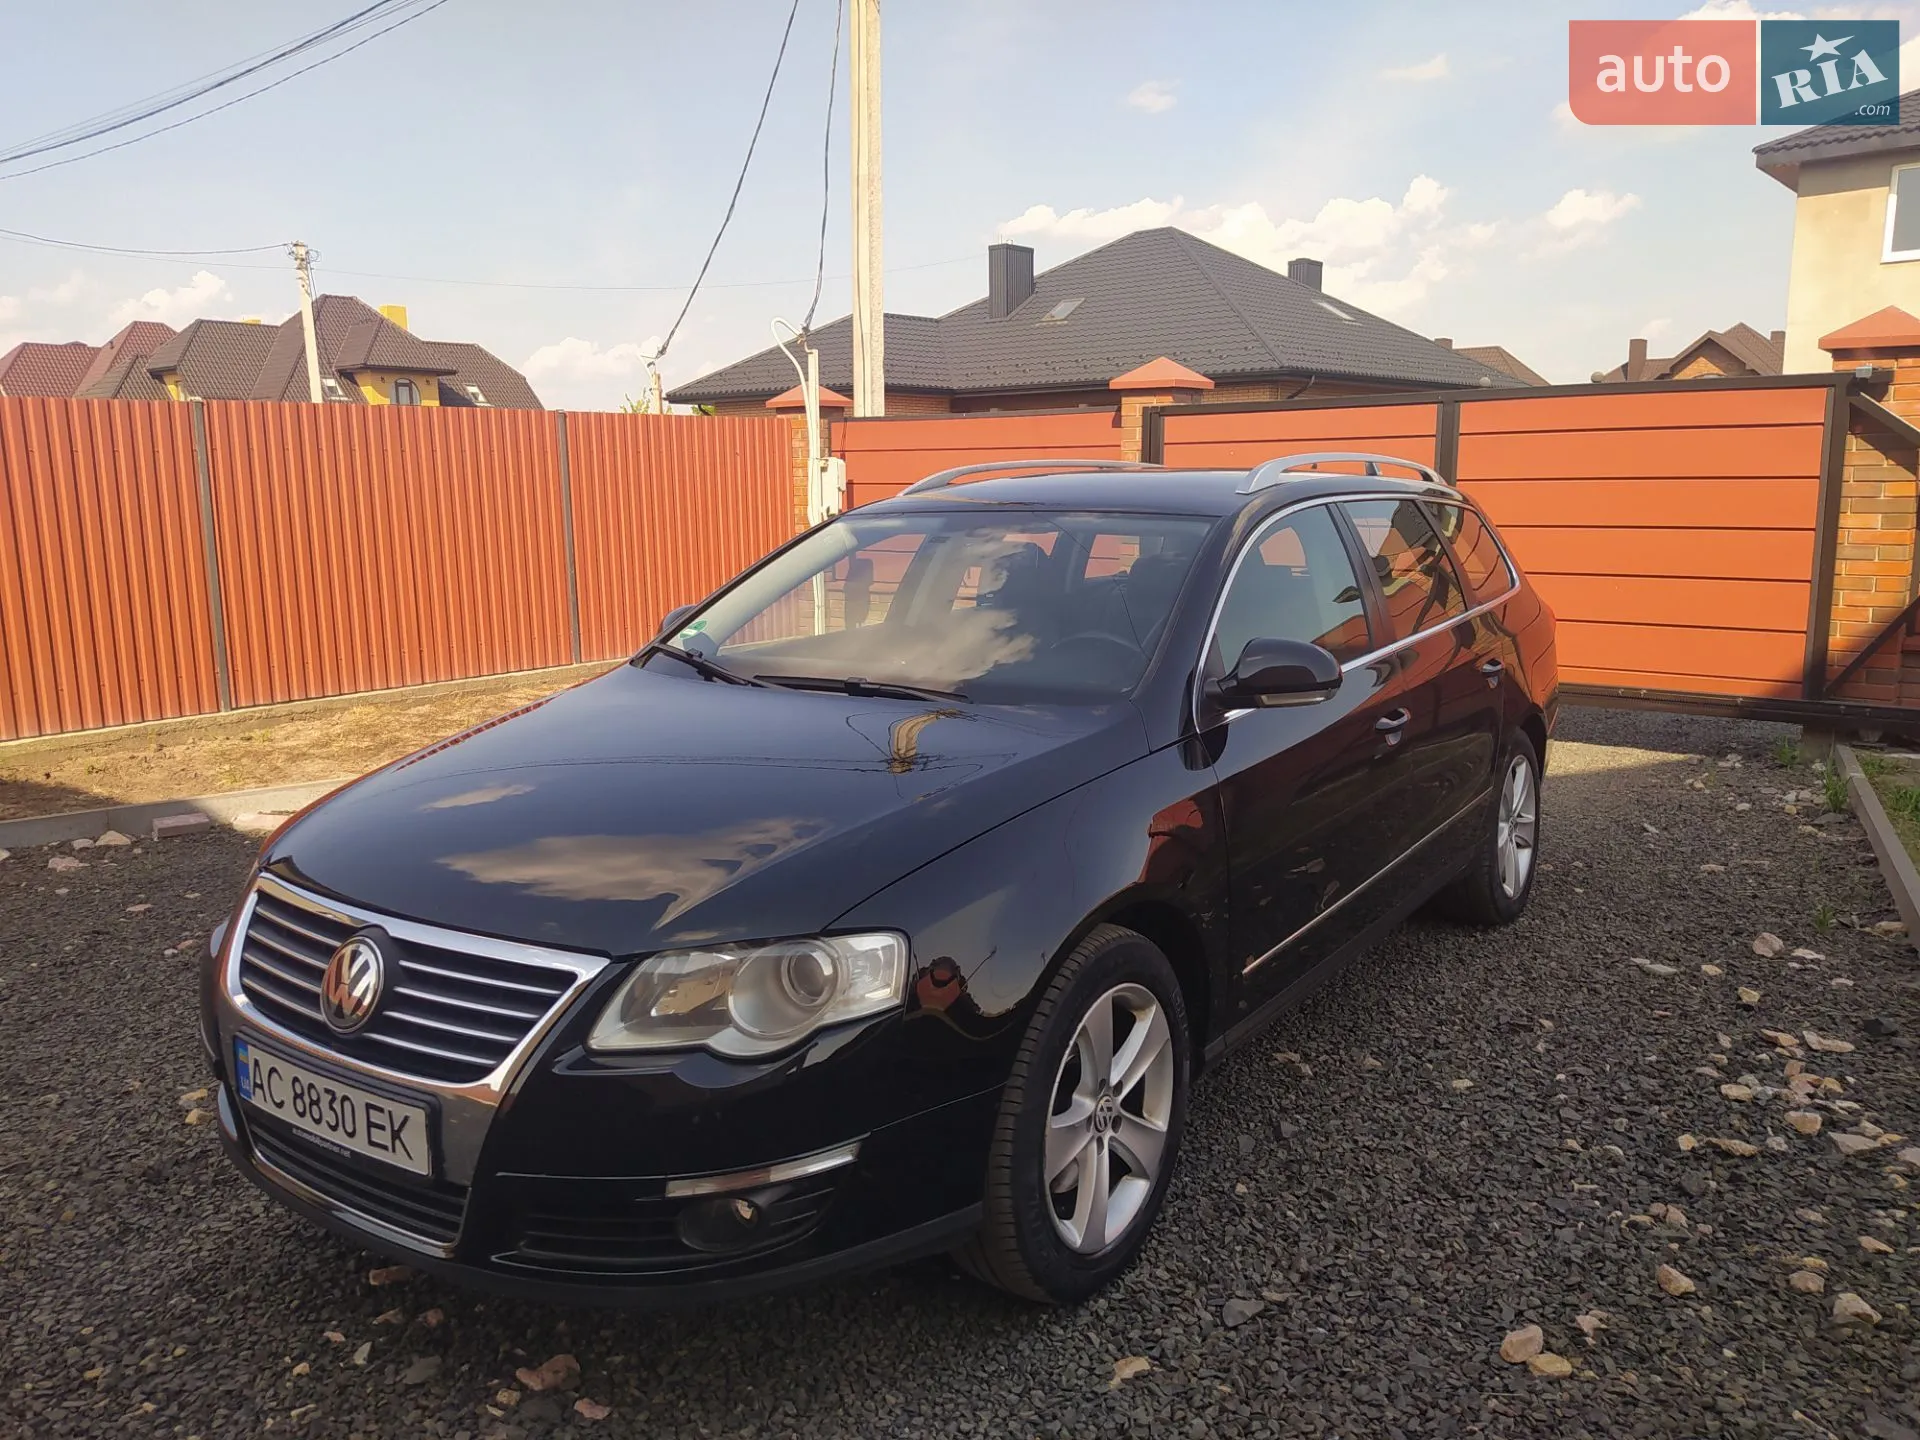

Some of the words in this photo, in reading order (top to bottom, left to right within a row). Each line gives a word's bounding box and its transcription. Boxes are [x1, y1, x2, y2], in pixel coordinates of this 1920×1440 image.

[252, 1058, 285, 1109] AC
[291, 1076, 357, 1139] 8830
[365, 1102, 414, 1161] EK
